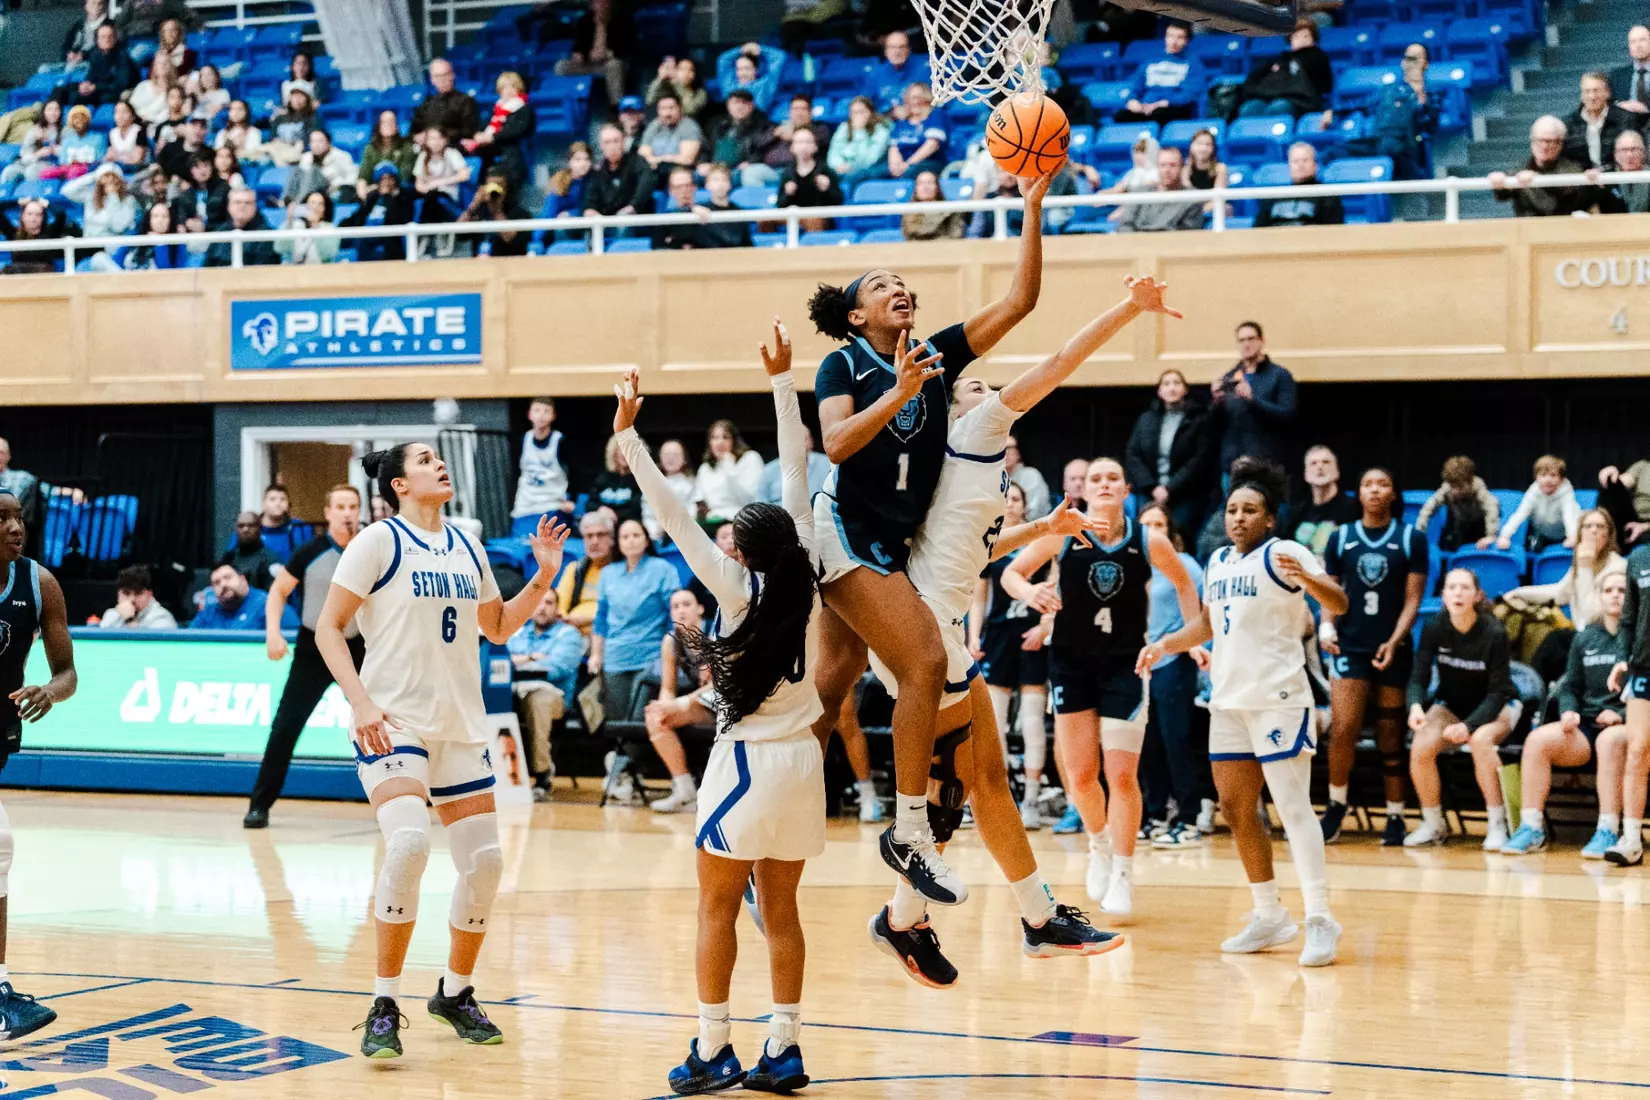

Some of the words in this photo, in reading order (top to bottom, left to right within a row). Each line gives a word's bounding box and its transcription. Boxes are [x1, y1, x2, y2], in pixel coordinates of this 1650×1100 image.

[284, 307, 466, 339] PIRATE
[1609, 307, 1629, 335] 4
[284, 337, 466, 355] ATHLETICS
[895, 452, 910, 491] 1
[870, 540, 893, 566] C
[411, 570, 451, 598] SETON
[1363, 590, 1379, 616] 3
[441, 606, 458, 643] 6
[1093, 607, 1113, 634] 4
[1223, 605, 1231, 635] 5
[168, 680, 272, 727] DELTA
